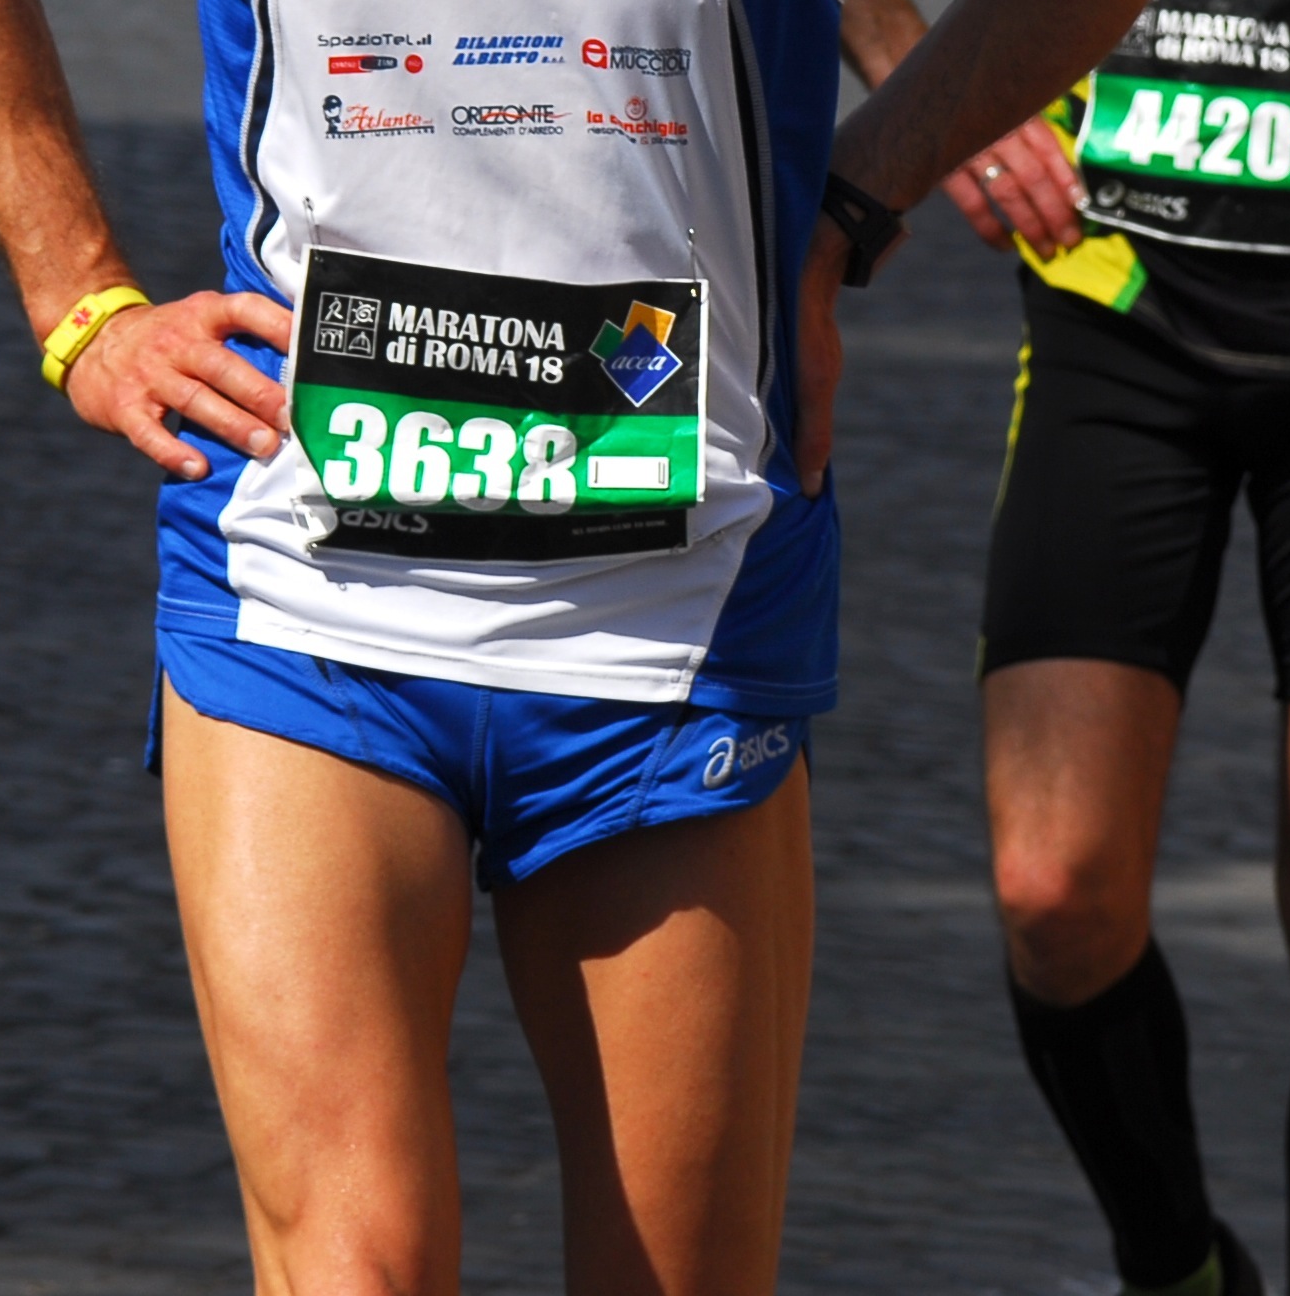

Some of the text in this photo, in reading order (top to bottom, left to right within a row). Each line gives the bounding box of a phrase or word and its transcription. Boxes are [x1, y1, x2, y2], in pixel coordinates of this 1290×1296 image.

[455, 36, 564, 50] BILANCIONI
[452, 51, 539, 65] ALBERTO
[610, 54, 691, 71] MUCCIOLI
[451, 105, 555, 125] ORIZZONTE
[388, 302, 565, 351] MARATONA
[386, 336, 564, 384] di ROMA 18
[611, 355, 667, 371] acea
[323, 403, 577, 514] 3638
